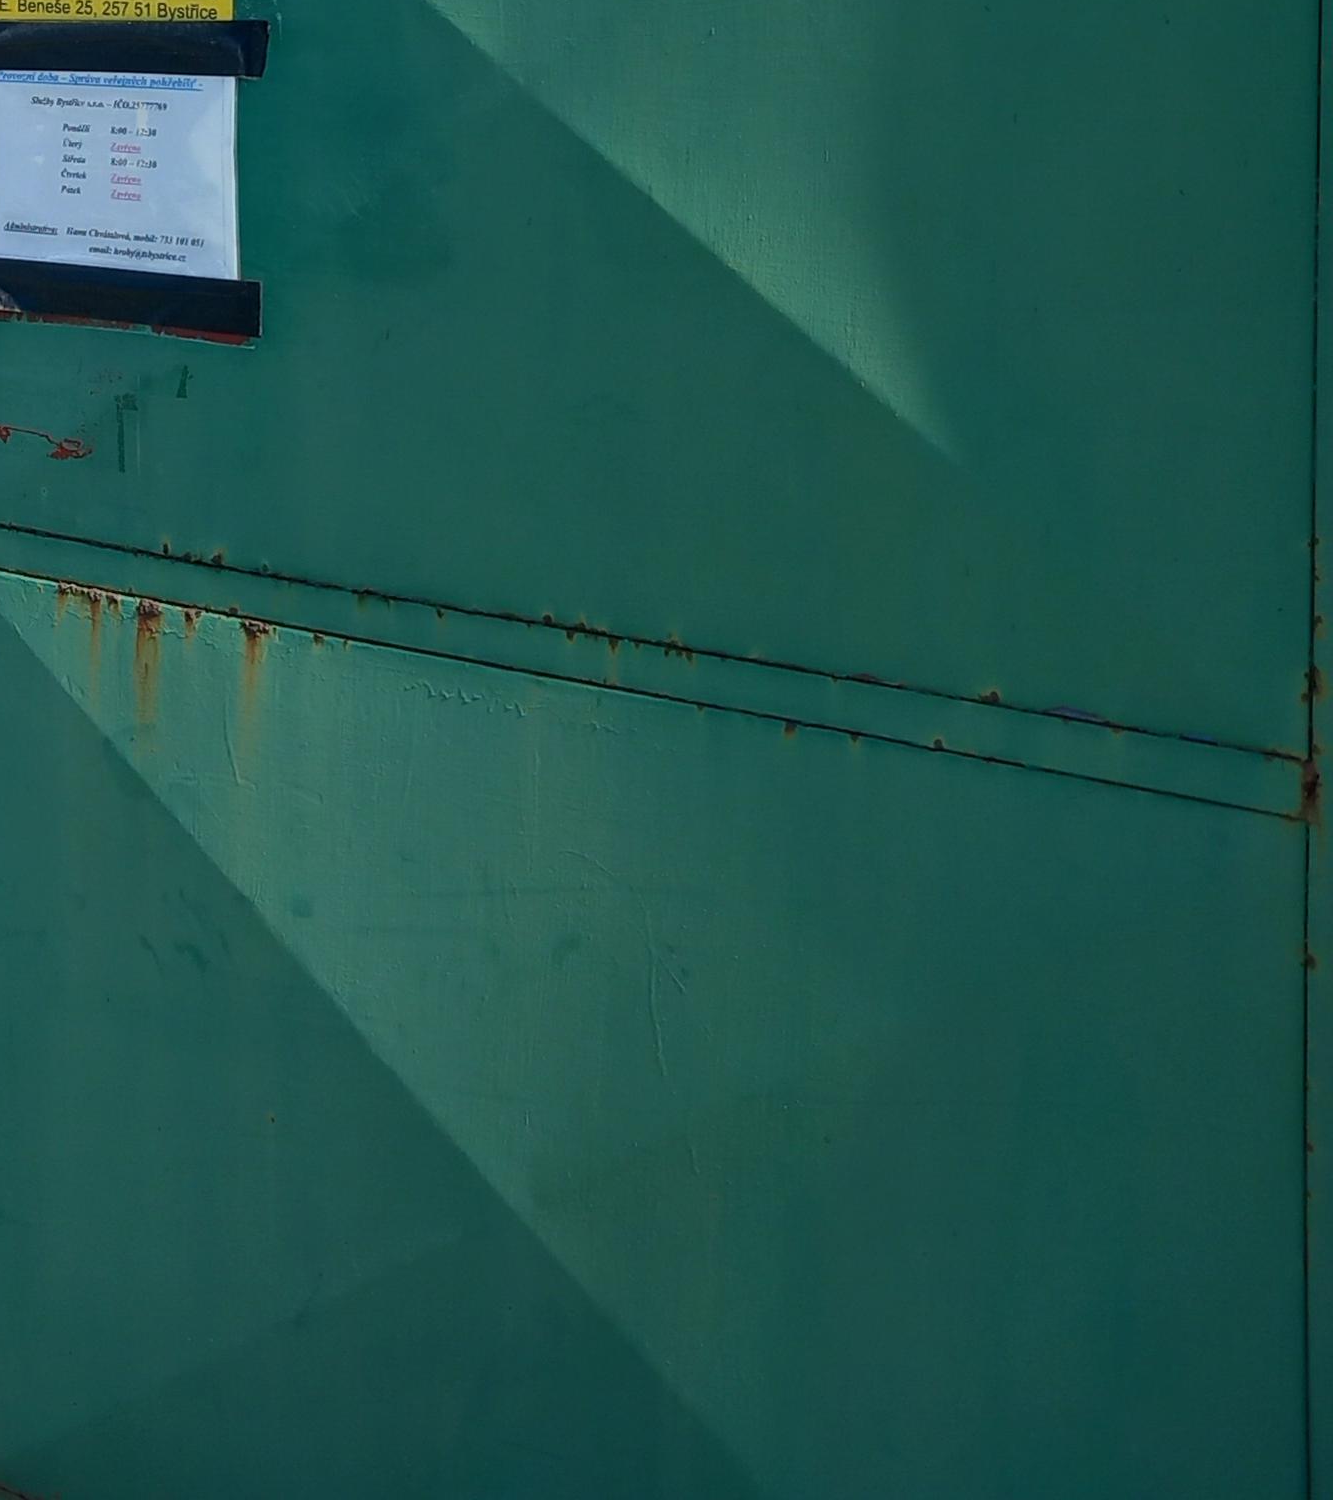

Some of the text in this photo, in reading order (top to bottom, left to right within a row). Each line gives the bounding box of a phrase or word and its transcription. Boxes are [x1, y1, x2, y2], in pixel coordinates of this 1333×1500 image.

[75, 0, 98, 17] 25,
[102, 1, 129, 16] 257
[134, 2, 151, 16] 51
[157, 2, 218, 21] Bystřice
